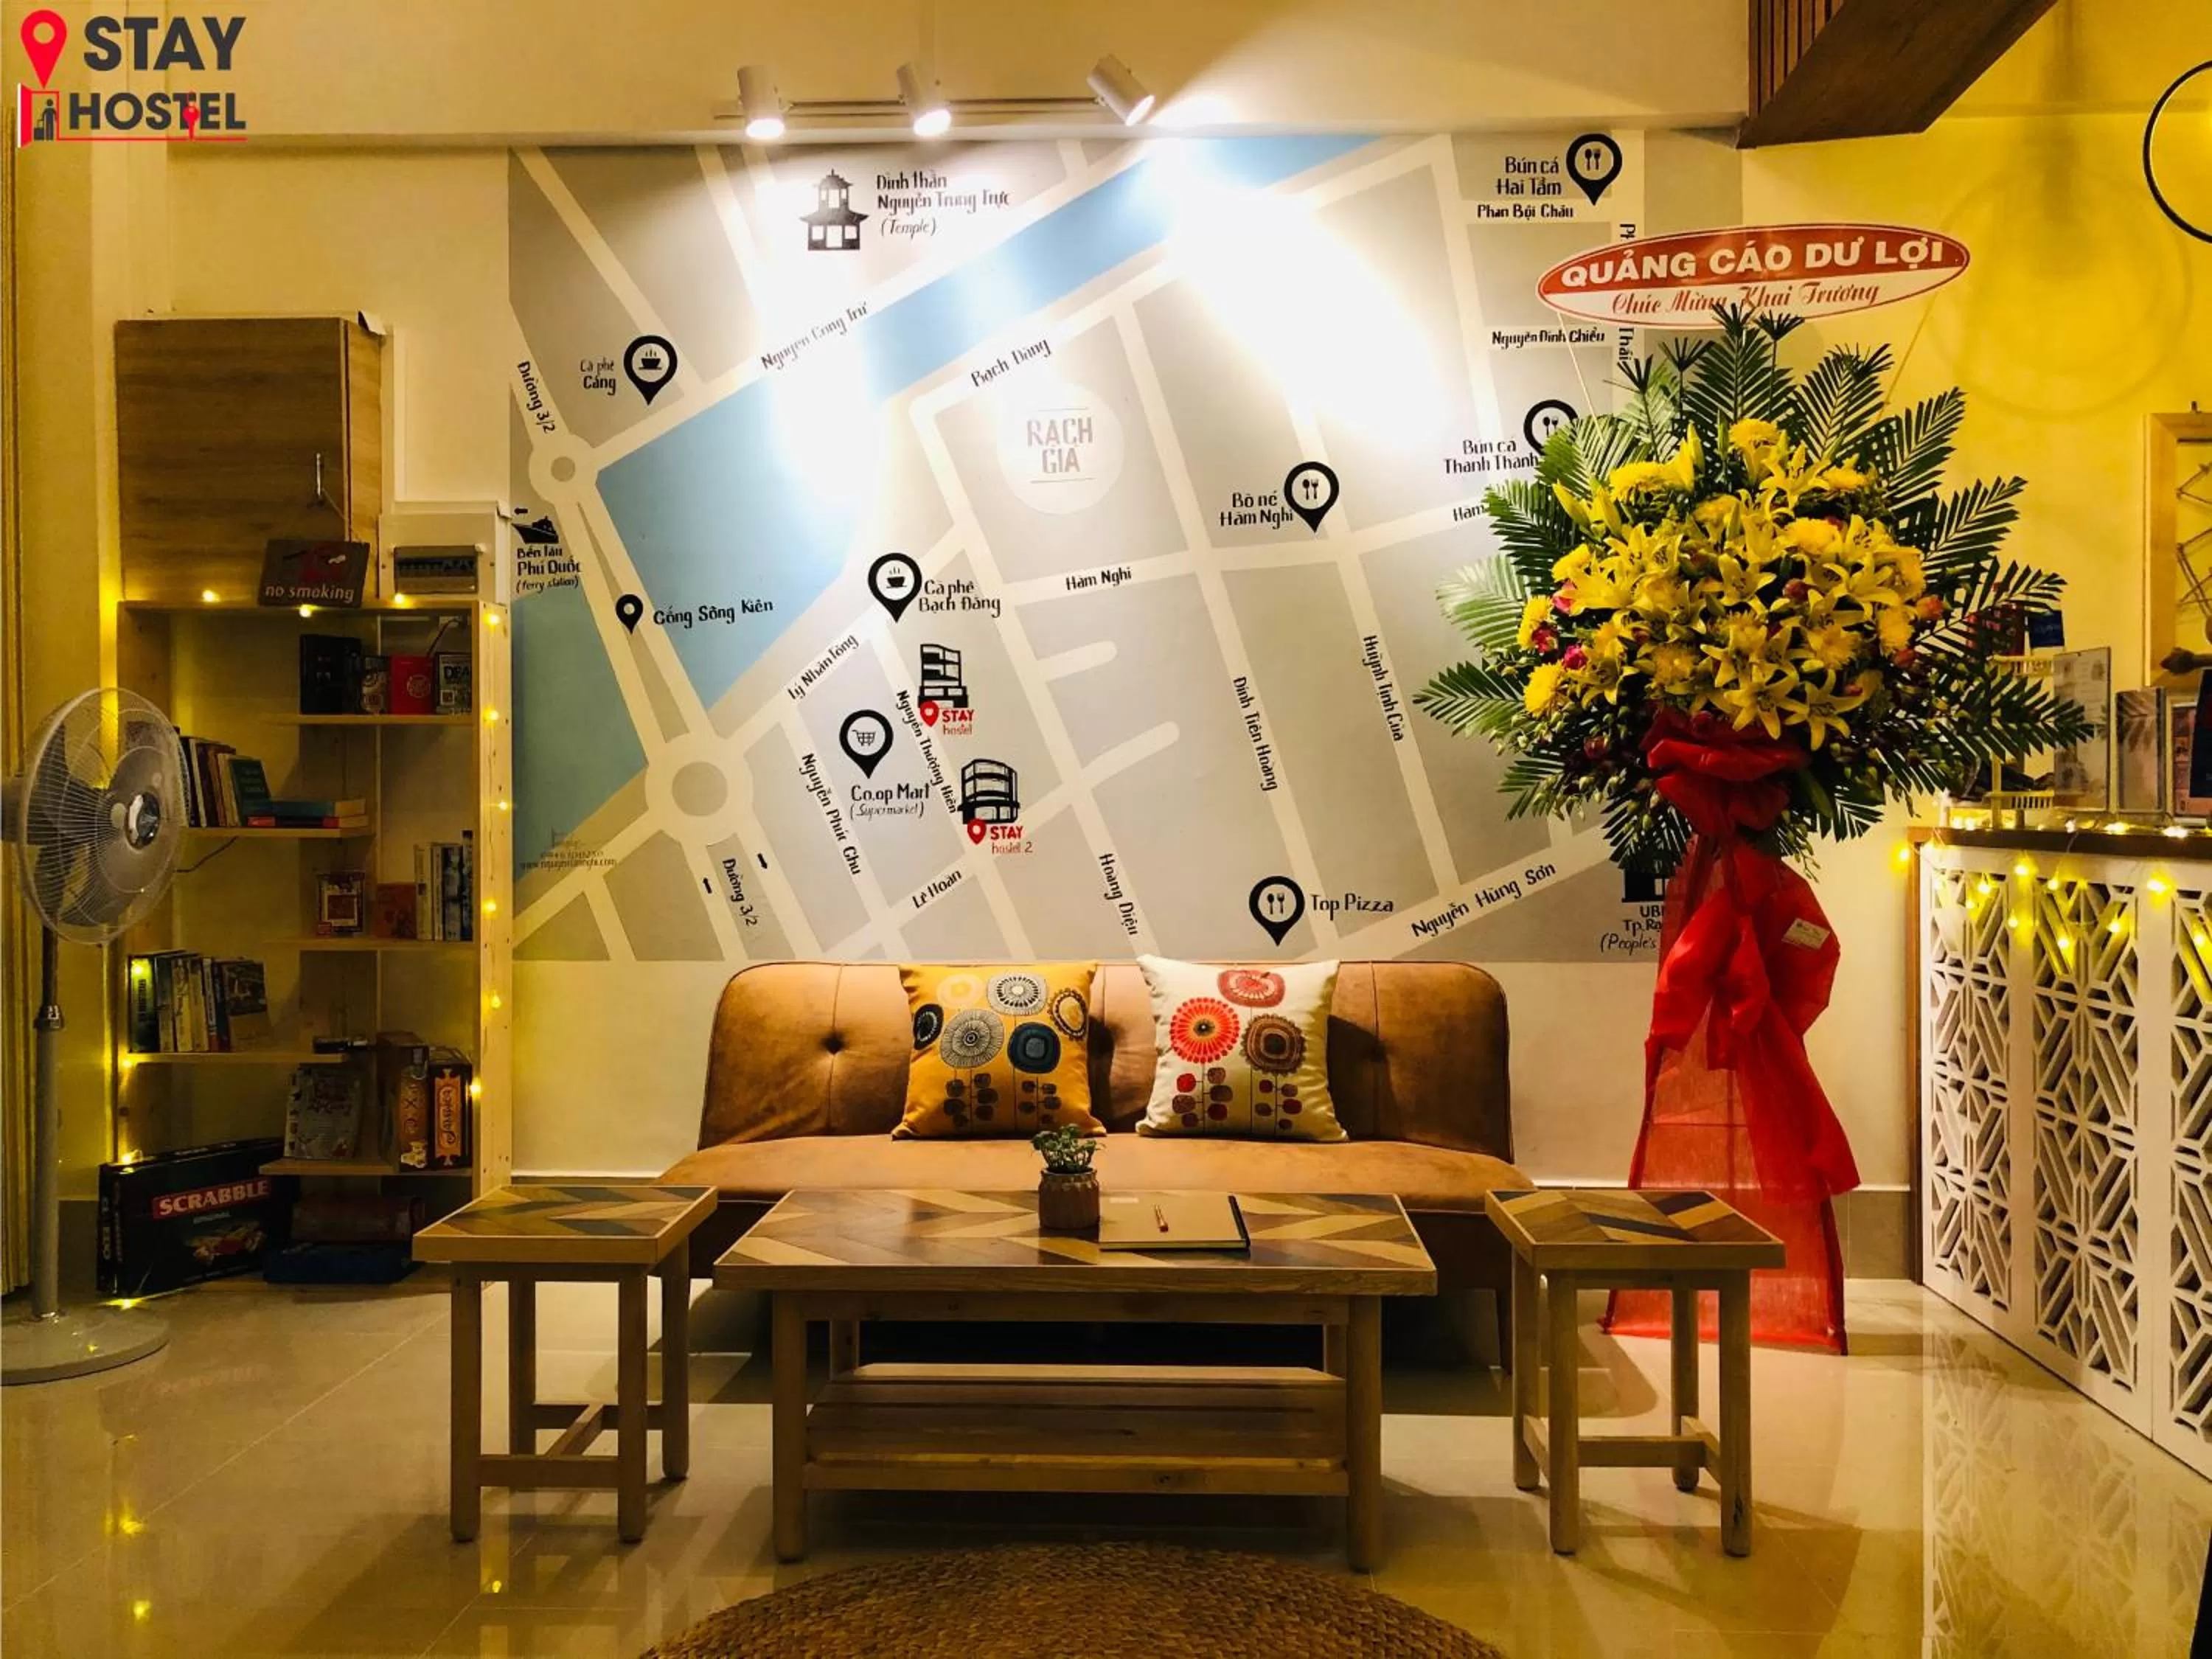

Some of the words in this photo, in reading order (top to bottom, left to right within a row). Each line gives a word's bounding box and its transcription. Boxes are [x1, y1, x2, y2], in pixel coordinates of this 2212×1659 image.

[1505, 156, 1537, 174] Bún
[1540, 156, 1559, 174] cá
[1495, 178, 1525, 195] Hai
[1477, 204, 1509, 218] Phan
[881, 217, 936, 240] (Temple)
[1561, 248, 1696, 288] QUẢNG
[1708, 240, 1793, 275] CÁO
[1805, 236, 1865, 270] DƯ
[1875, 236, 1944, 269] LỢI
[1612, 292, 1662, 315] Chúc
[1664, 290, 1728, 314] Mừng
[1739, 285, 1793, 308] Khai
[1801, 281, 1880, 307] Trương
[535, 411, 555, 434] 3/2
[1444, 455, 1491, 474] Thanh
[1260, 507, 1294, 530] Nghi
[517, 559, 545, 576] Phú
[1101, 566, 1132, 587] Nghi
[265, 585, 285, 598] no
[288, 582, 355, 605] smoking
[947, 578, 975, 600] phê
[653, 605, 693, 629] Cống
[698, 605, 736, 625] Sông
[741, 598, 774, 615] Kiên
[919, 597, 956, 614] Bạch
[942, 709, 975, 723] STAY
[942, 724, 973, 736] hostel
[851, 784, 894, 805] Co.op
[897, 782, 931, 800] Mart
[850, 801, 925, 821] (Supermarket)
[990, 825, 1024, 841] STAY
[992, 842, 1022, 855] hostel
[1024, 841, 1034, 854] 2
[842, 845, 862, 876] Chu
[1524, 862, 1557, 887] Sơn
[740, 903, 761, 928] 3/2
[1311, 894, 1340, 921] Top
[1344, 892, 1394, 914] Pizza
[1639, 904, 1665, 919] UB
[1601, 932, 1657, 956] (People's
[158, 1179, 271, 1217] SCRABBLE
